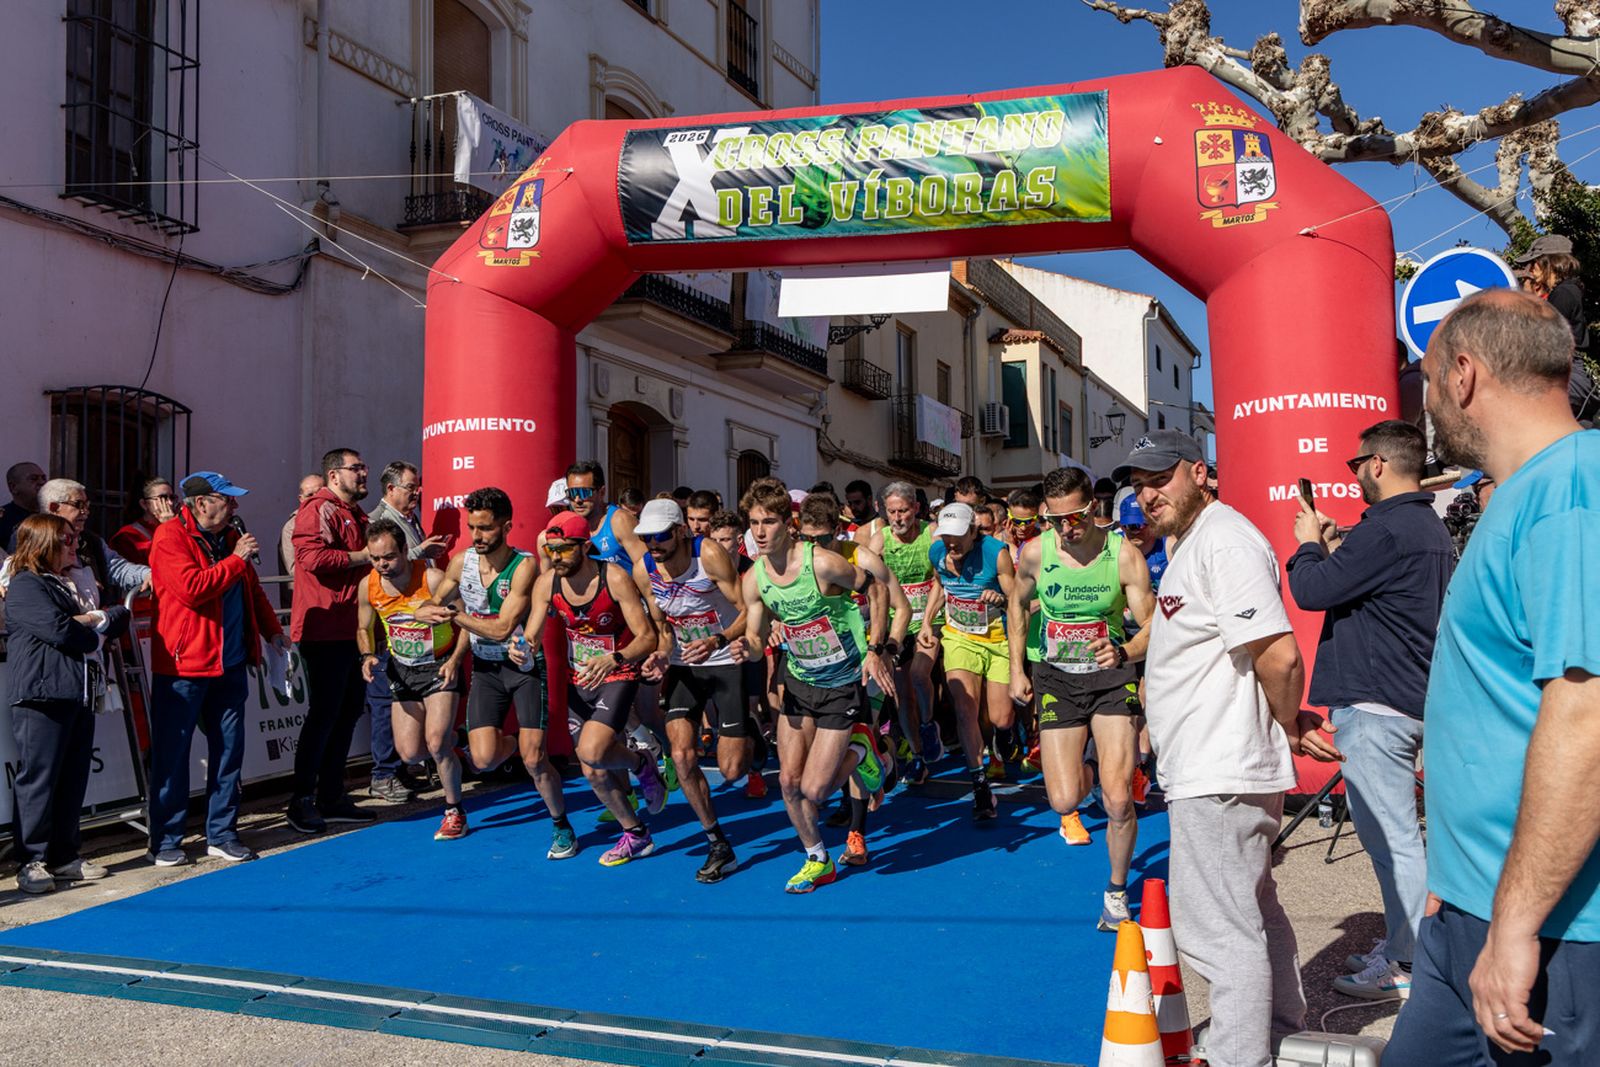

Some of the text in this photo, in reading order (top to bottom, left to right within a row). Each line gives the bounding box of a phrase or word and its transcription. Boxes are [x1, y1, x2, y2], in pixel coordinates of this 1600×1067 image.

[481, 112, 511, 138] CROSS
[668, 132, 706, 143] 2026
[651, 109, 1066, 240] X CROSS PANTANO
[715, 166, 1058, 230] DEL VÍBORAS
[1222, 214, 1255, 225] MARTOS
[1233, 392, 1388, 420] AYUNTAMIENTO
[1298, 437, 1328, 453] DE
[452, 456, 475, 470] DE
[1064, 584, 1111, 593] Fundación
[1064, 593, 1099, 602] Unicaja
[392, 627, 401, 636] X
[1055, 624, 1099, 637] X CROSS
